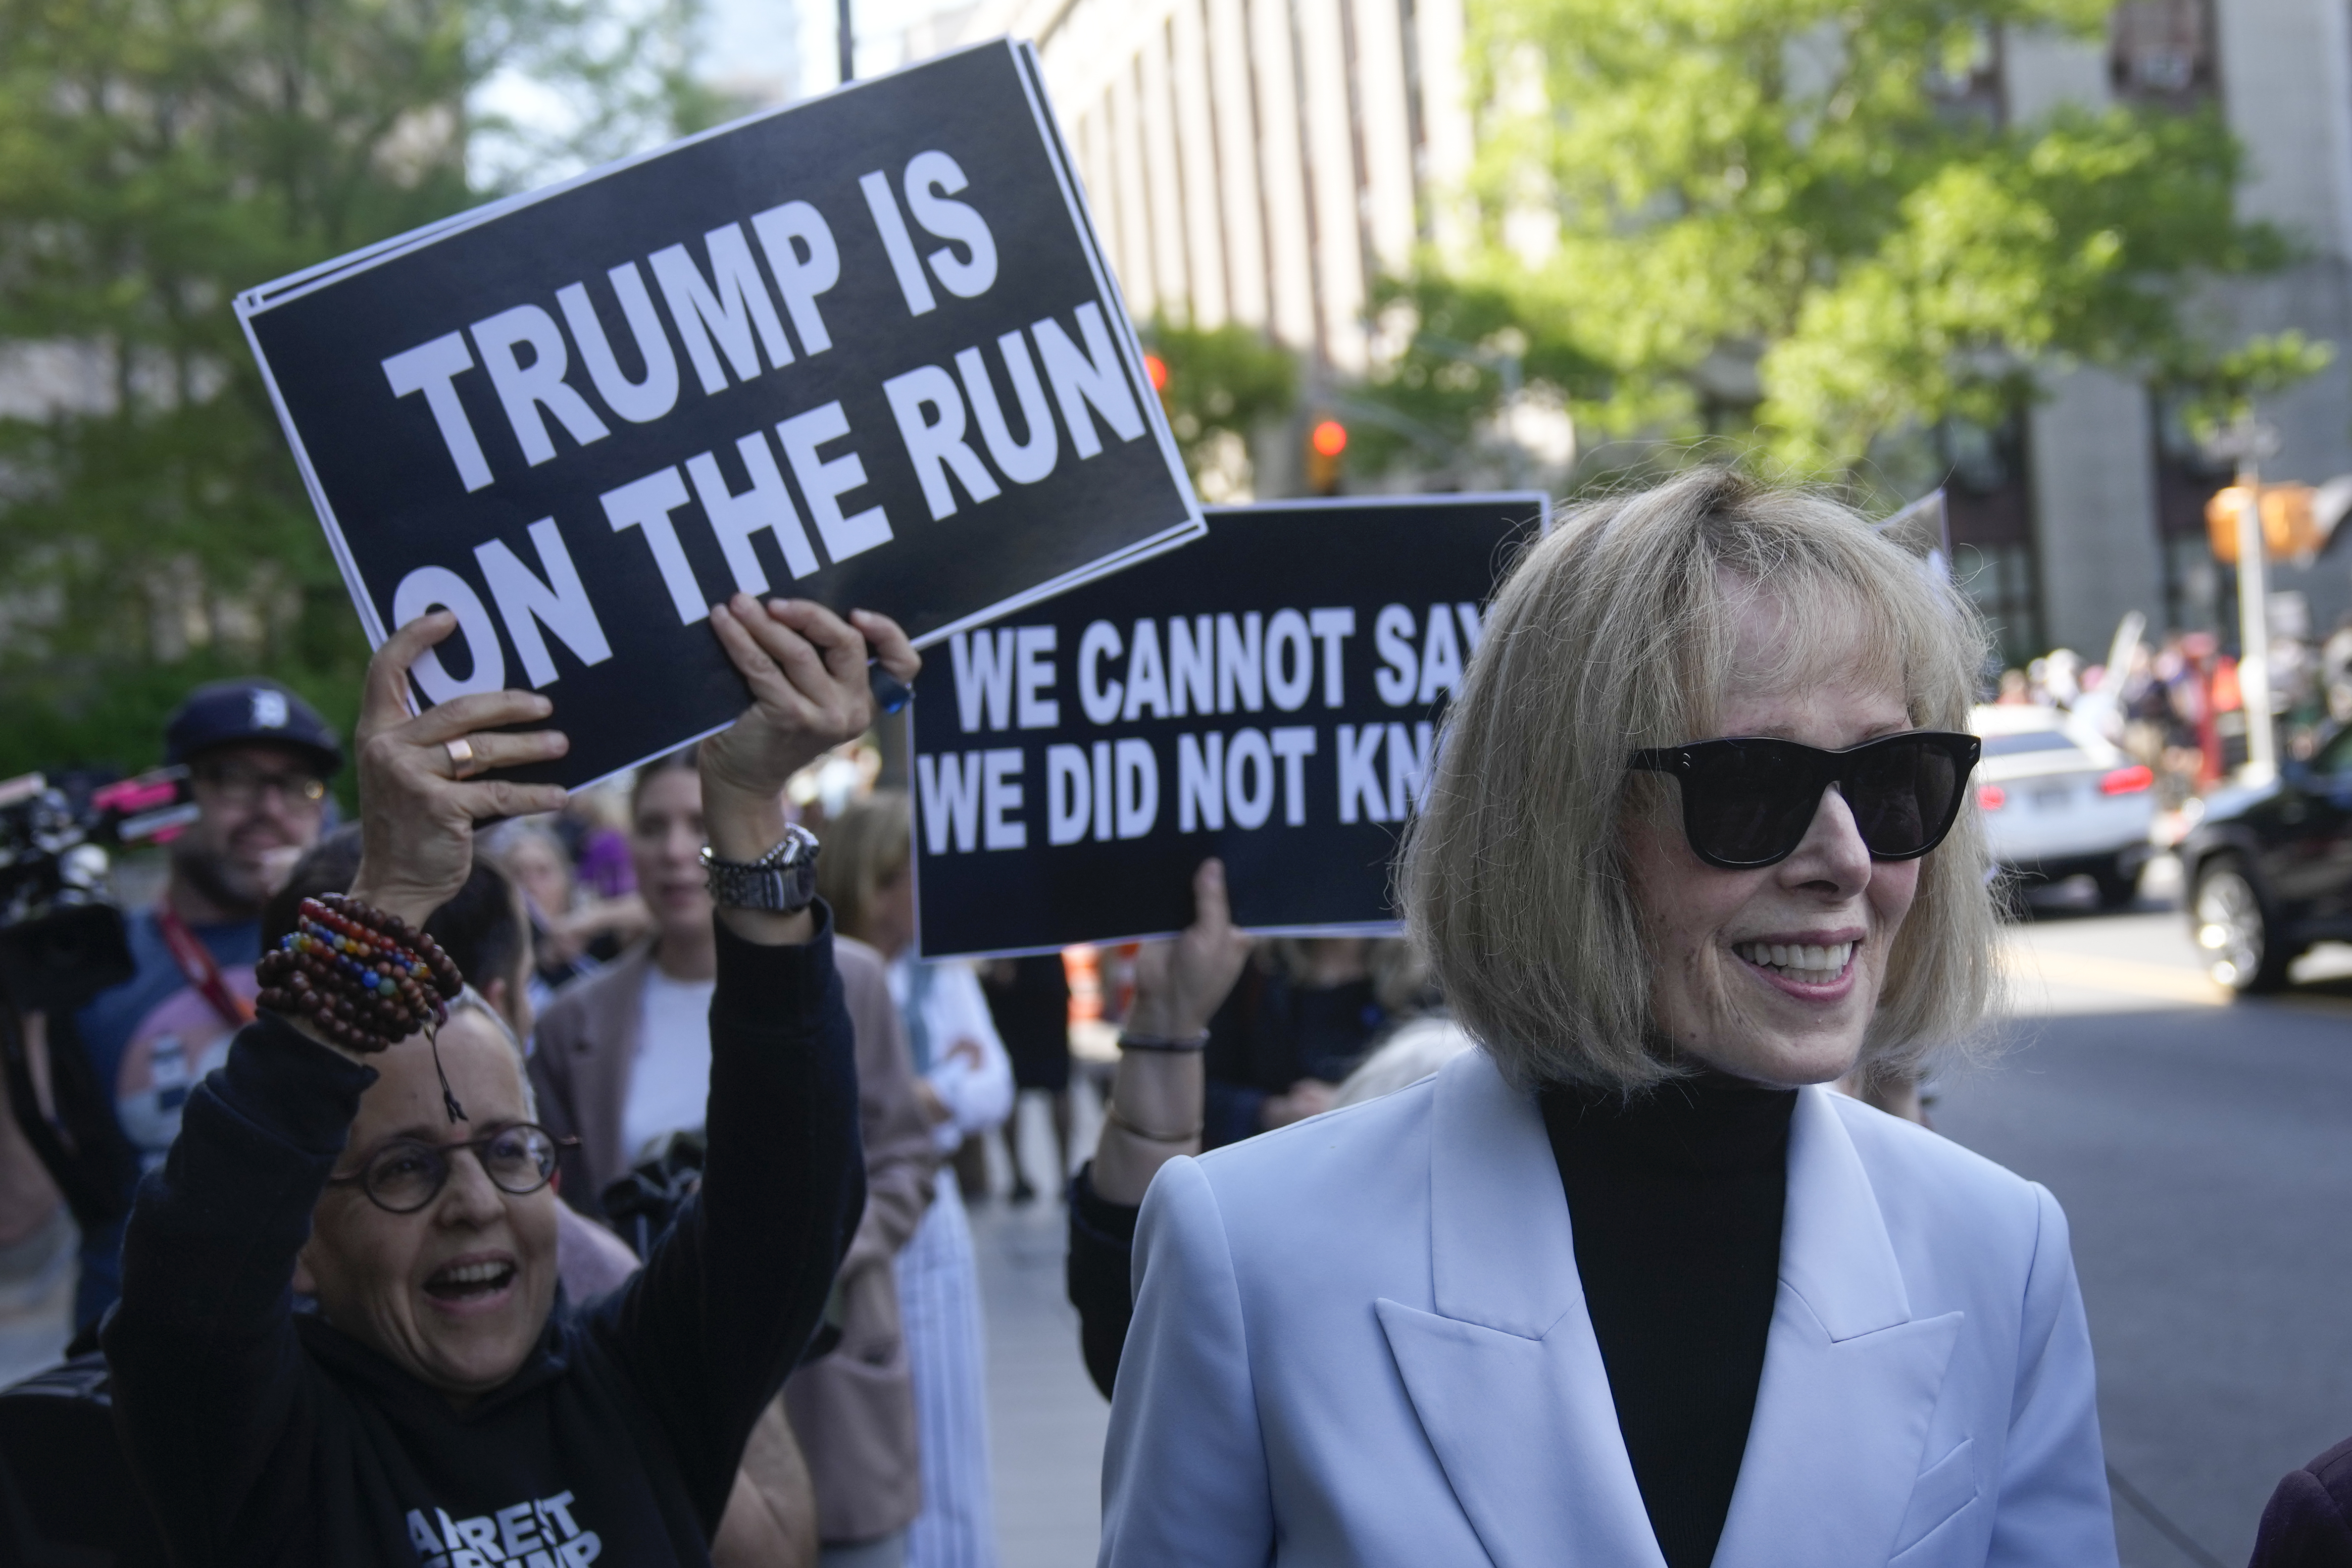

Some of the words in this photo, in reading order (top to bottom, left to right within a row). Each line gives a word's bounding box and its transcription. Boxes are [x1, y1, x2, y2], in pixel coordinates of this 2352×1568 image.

[381, 199, 840, 492] TRUMP
[858, 149, 998, 316] IS
[393, 516, 613, 706] ON
[599, 400, 893, 626] THE
[882, 300, 1146, 521] RUN
[949, 625, 1059, 733] WE
[1078, 608, 1356, 724] CANNOT
[917, 748, 1027, 855] WE
[1046, 738, 1159, 845] DID
[1178, 726, 1317, 833] NOT
